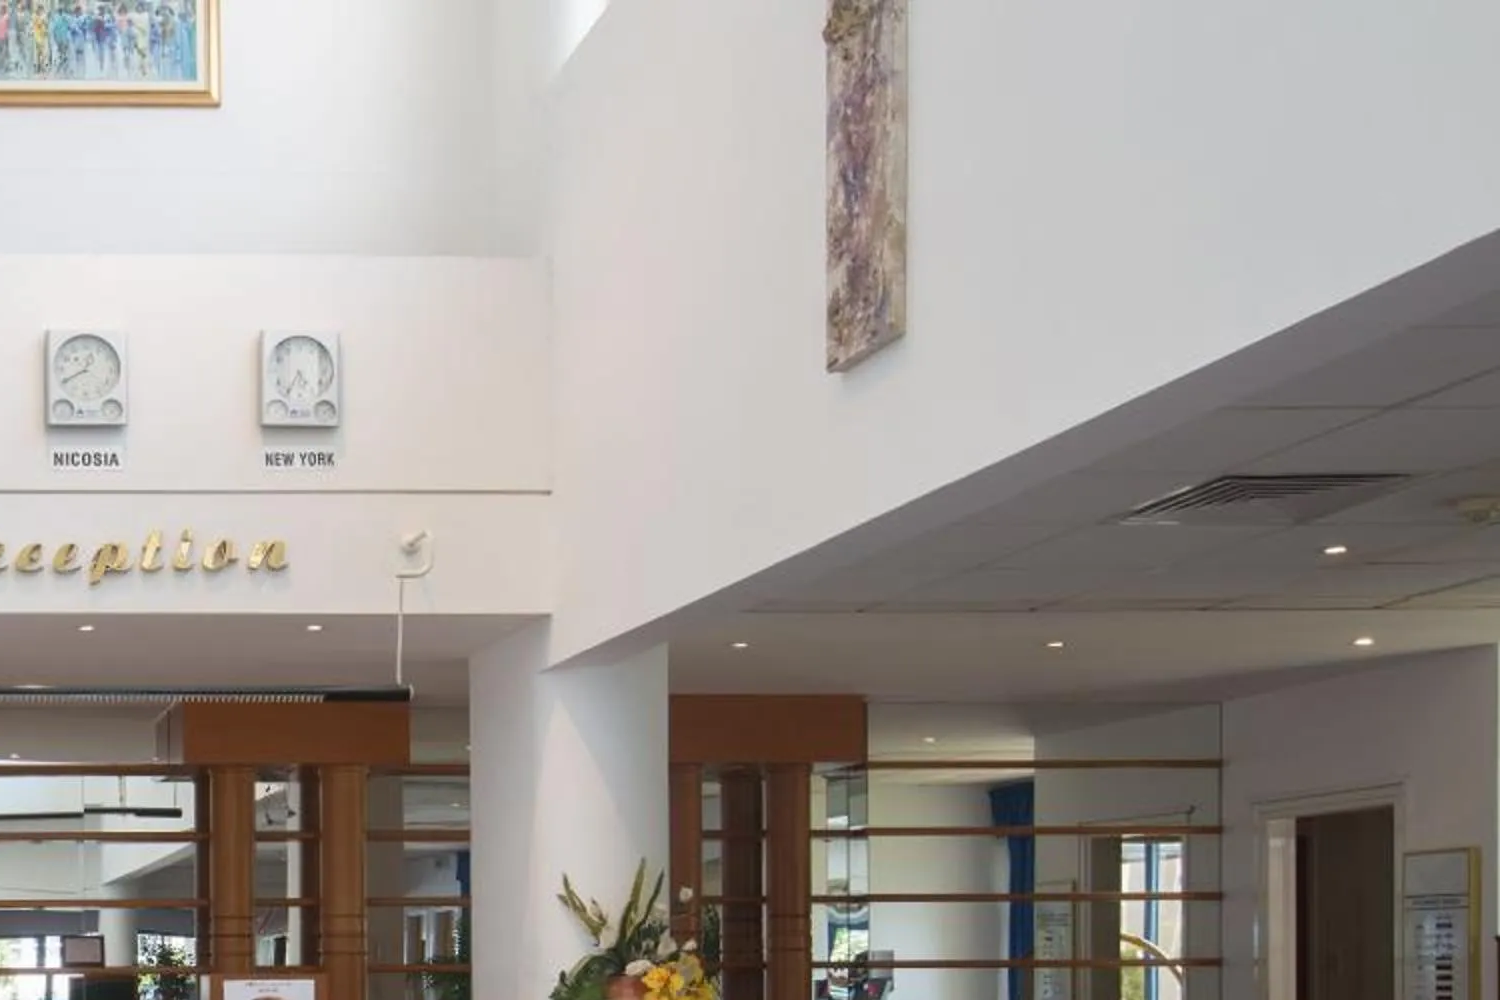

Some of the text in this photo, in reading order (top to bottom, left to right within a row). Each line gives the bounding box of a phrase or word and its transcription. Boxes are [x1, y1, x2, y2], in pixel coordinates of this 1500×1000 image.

[53, 451, 120, 467] NICOSIA
[265, 451, 335, 467] NEW YORK
